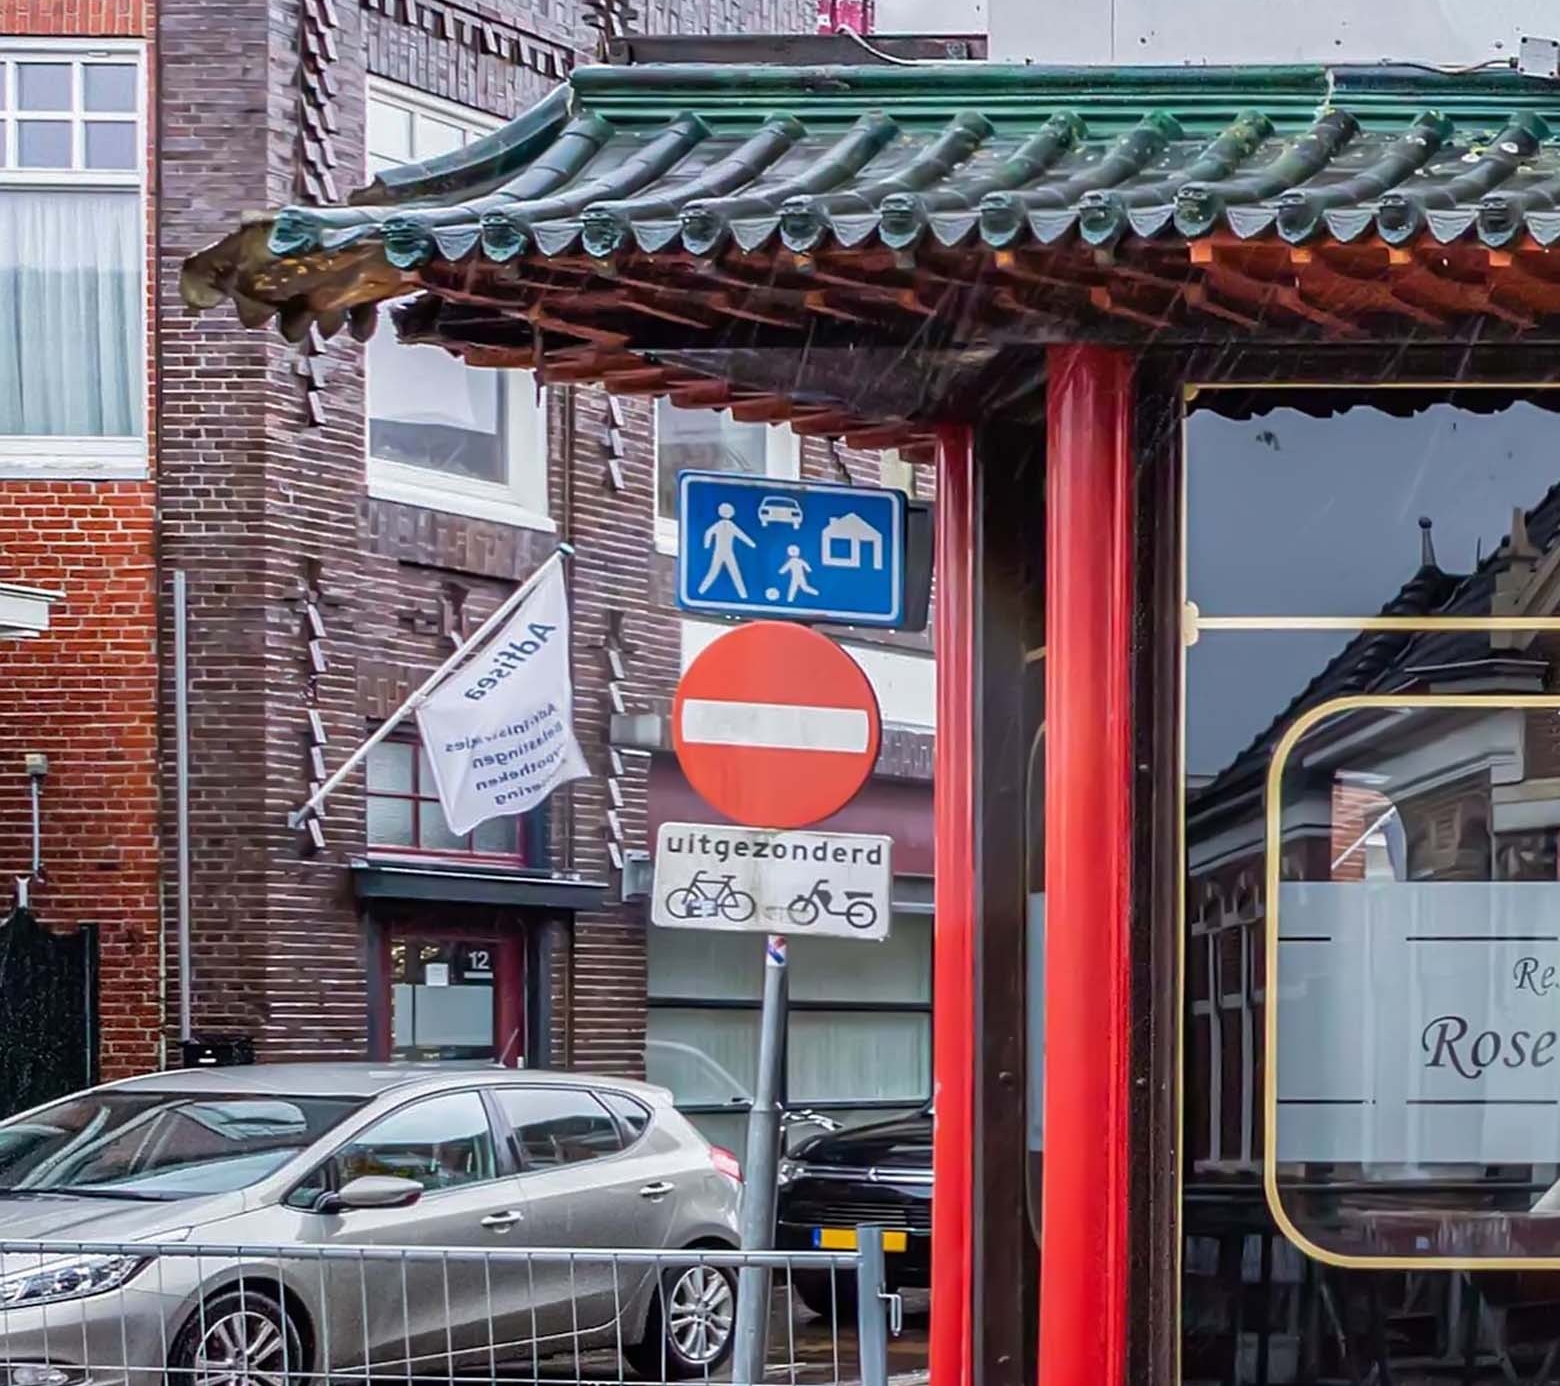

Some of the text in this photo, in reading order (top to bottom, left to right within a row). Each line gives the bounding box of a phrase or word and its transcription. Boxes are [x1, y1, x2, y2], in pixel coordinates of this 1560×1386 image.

[667, 834, 882, 865] uitgezonderd
[468, 951, 490, 969] 12
[1421, 1015, 1557, 1079] Rose
